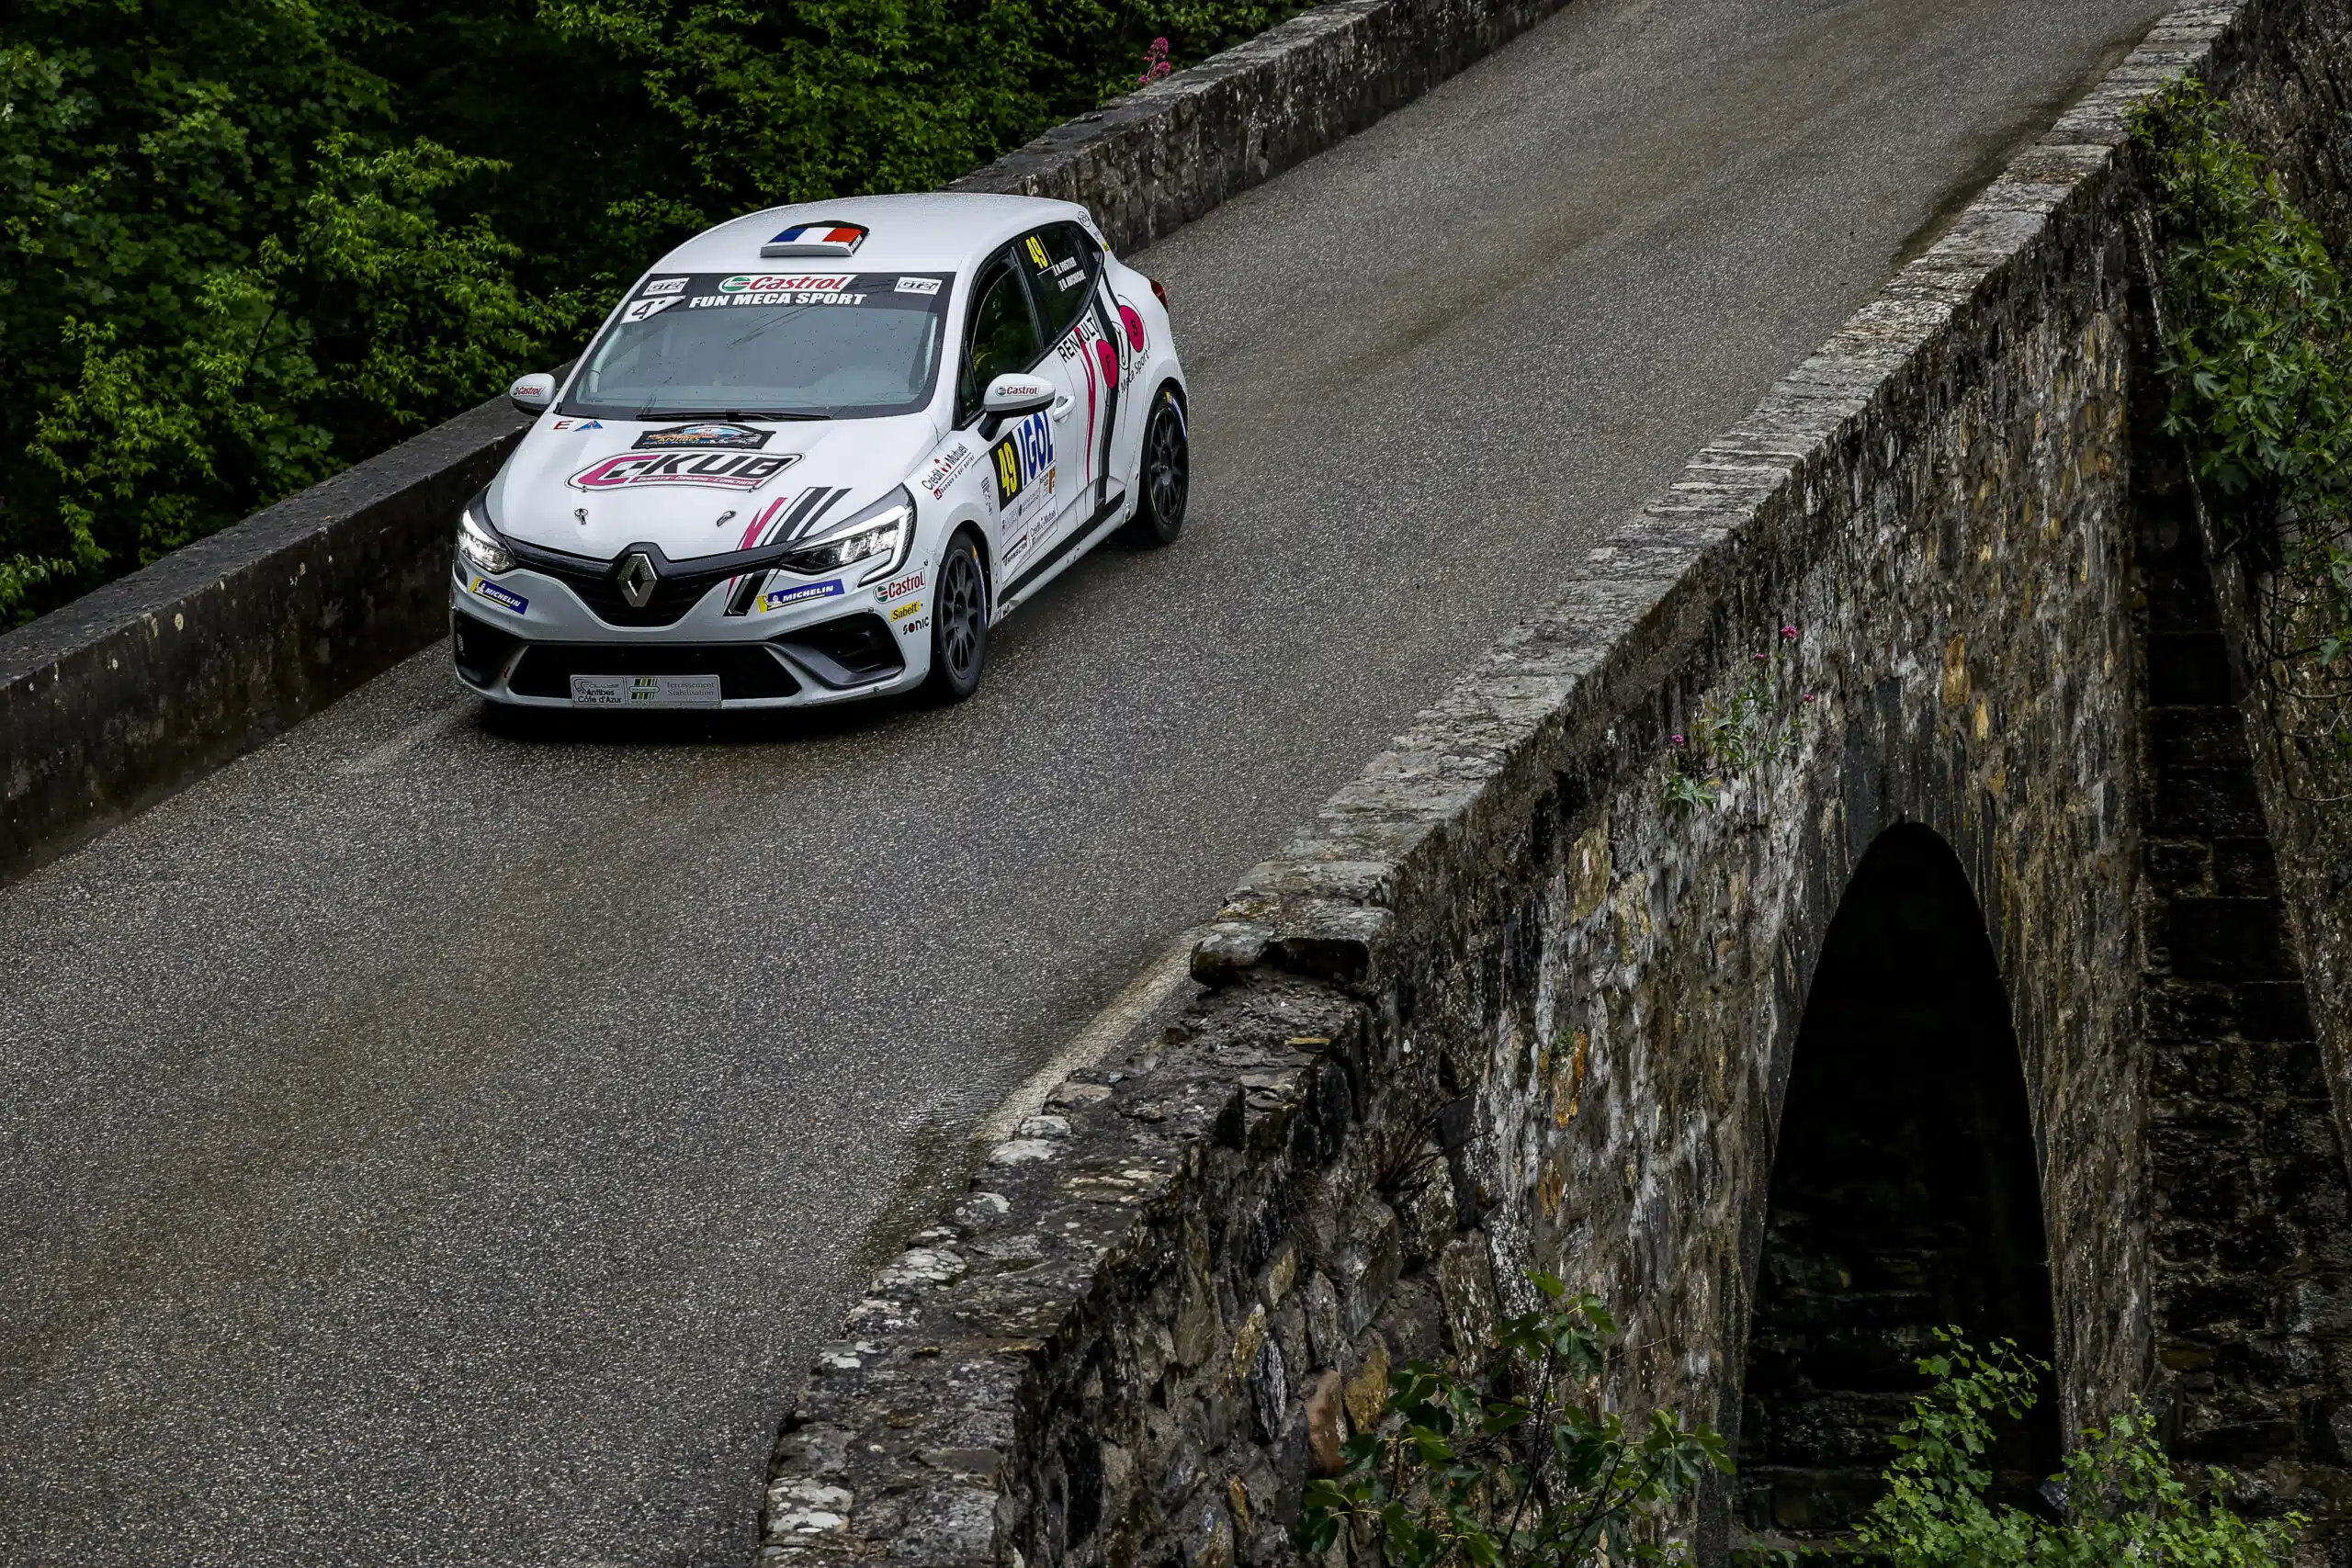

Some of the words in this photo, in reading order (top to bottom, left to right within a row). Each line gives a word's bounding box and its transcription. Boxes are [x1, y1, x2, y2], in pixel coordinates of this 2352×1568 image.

[1025, 236, 1048, 269] 49
[750, 276, 848, 291] Castrol
[689, 295, 730, 309] FUN
[732, 292, 790, 306] MECA
[796, 293, 867, 305] SPORT
[1057, 316, 1098, 364] RENAULT
[1134, 349, 1150, 375] Sport
[517, 386, 542, 396] Castrol
[1006, 386, 1038, 396] Castrol
[1017, 410, 1054, 487] IGOL
[922, 468, 945, 491] Crédit
[944, 442, 968, 466] Mutuel
[997, 442, 1018, 498] 49
[782, 584, 834, 603] MICHELIN
[888, 572, 925, 598] Castrol
[483, 587, 521, 608] MICHELIN
[892, 603, 919, 621] Sabelt
